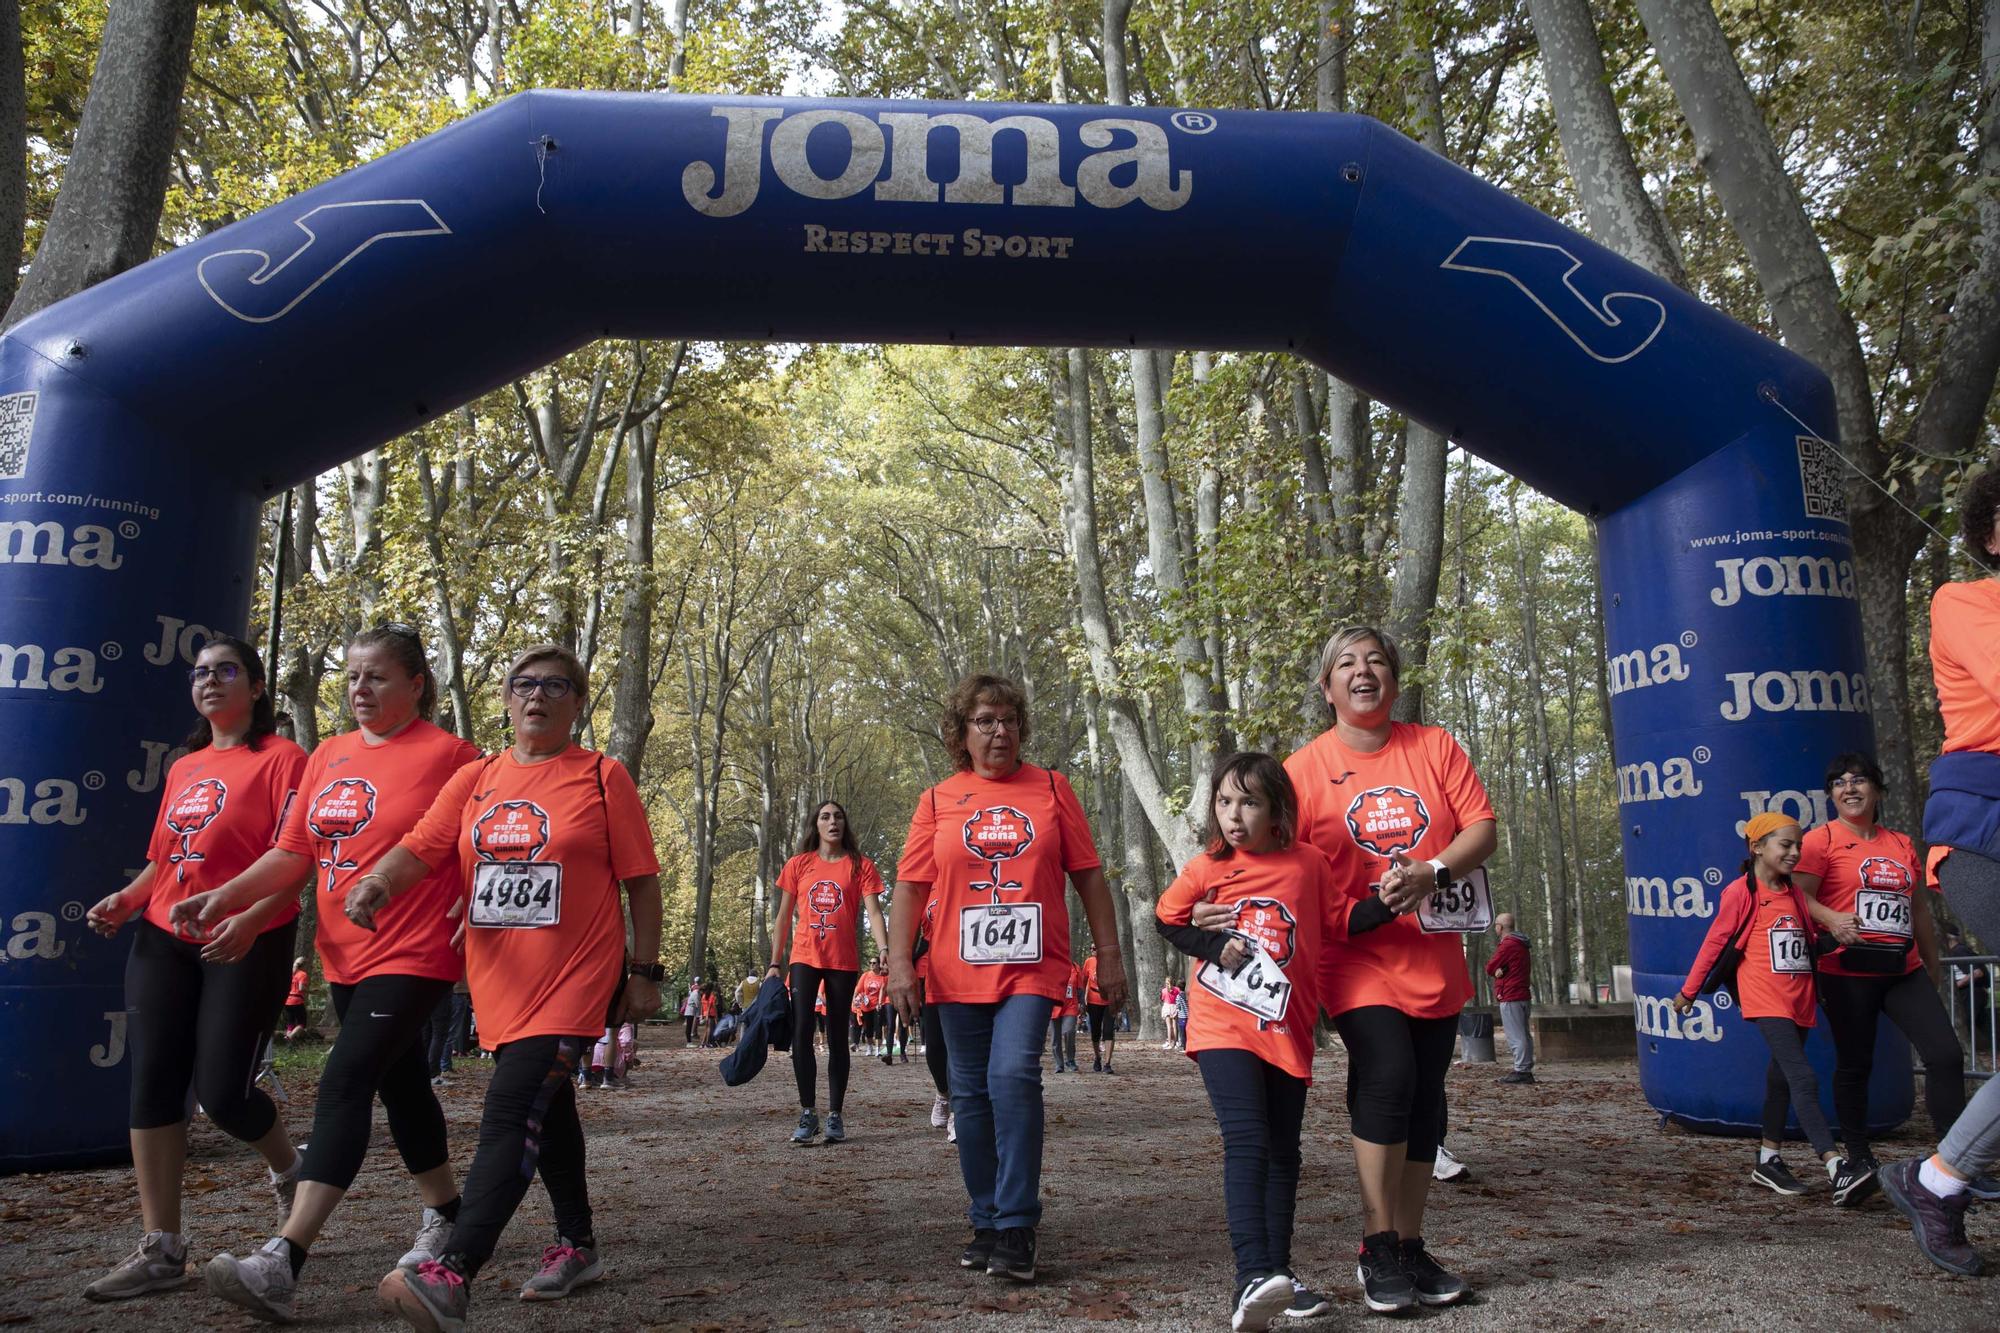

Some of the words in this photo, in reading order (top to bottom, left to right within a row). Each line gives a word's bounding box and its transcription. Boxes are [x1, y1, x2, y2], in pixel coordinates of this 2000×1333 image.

[176, 804, 208, 815] dona
[318, 806, 357, 818] dona
[1367, 807, 1405, 818] cursa
[1365, 816, 1412, 832] dona
[487, 831, 531, 844] dona
[977, 831, 1018, 840] dona
[1376, 830, 1407, 840] GIRONA
[1872, 876, 1900, 886] dona
[478, 878, 553, 908] 4984
[1864, 902, 1909, 924] 1045
[970, 918, 1032, 947] 1641
[1243, 920, 1278, 937] cursa
